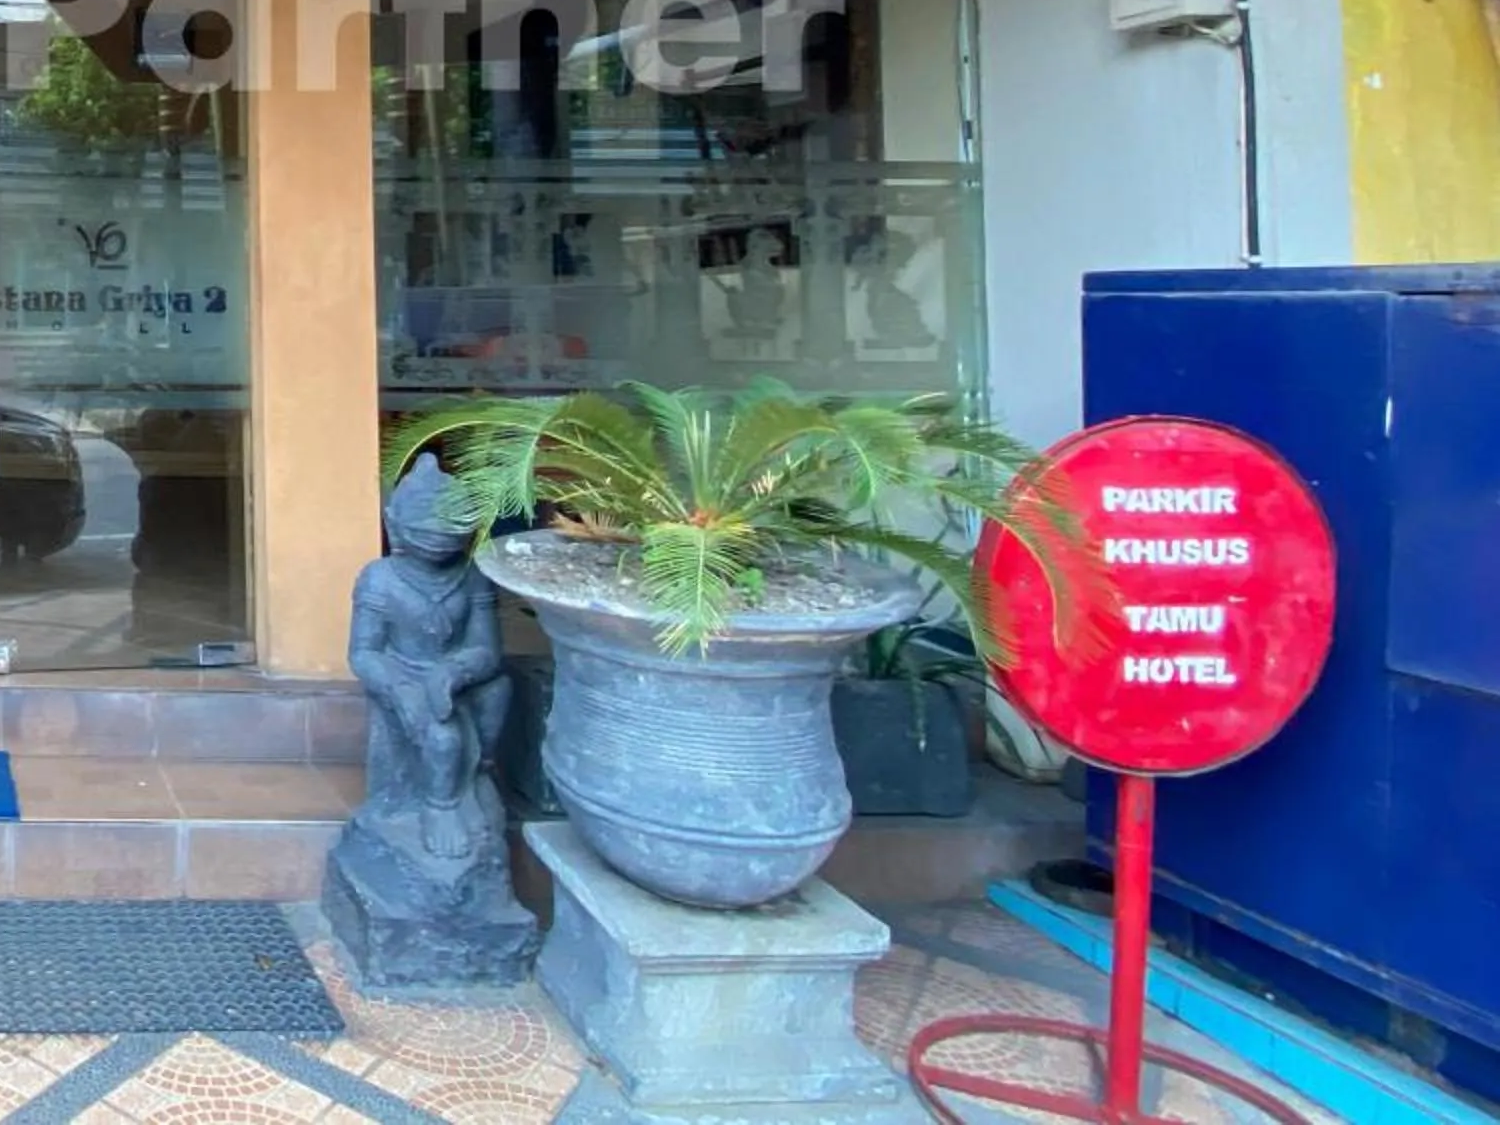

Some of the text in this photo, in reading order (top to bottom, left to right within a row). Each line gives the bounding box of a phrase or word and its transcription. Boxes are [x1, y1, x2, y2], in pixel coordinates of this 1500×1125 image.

[99, 285, 194, 318] Griya
[203, 285, 228, 313] 2
[1102, 486, 1238, 515] PARKIR
[1104, 538, 1250, 566] KHUSUS
[1122, 605, 1225, 634] TAMU
[1123, 656, 1238, 684] HOTEL
